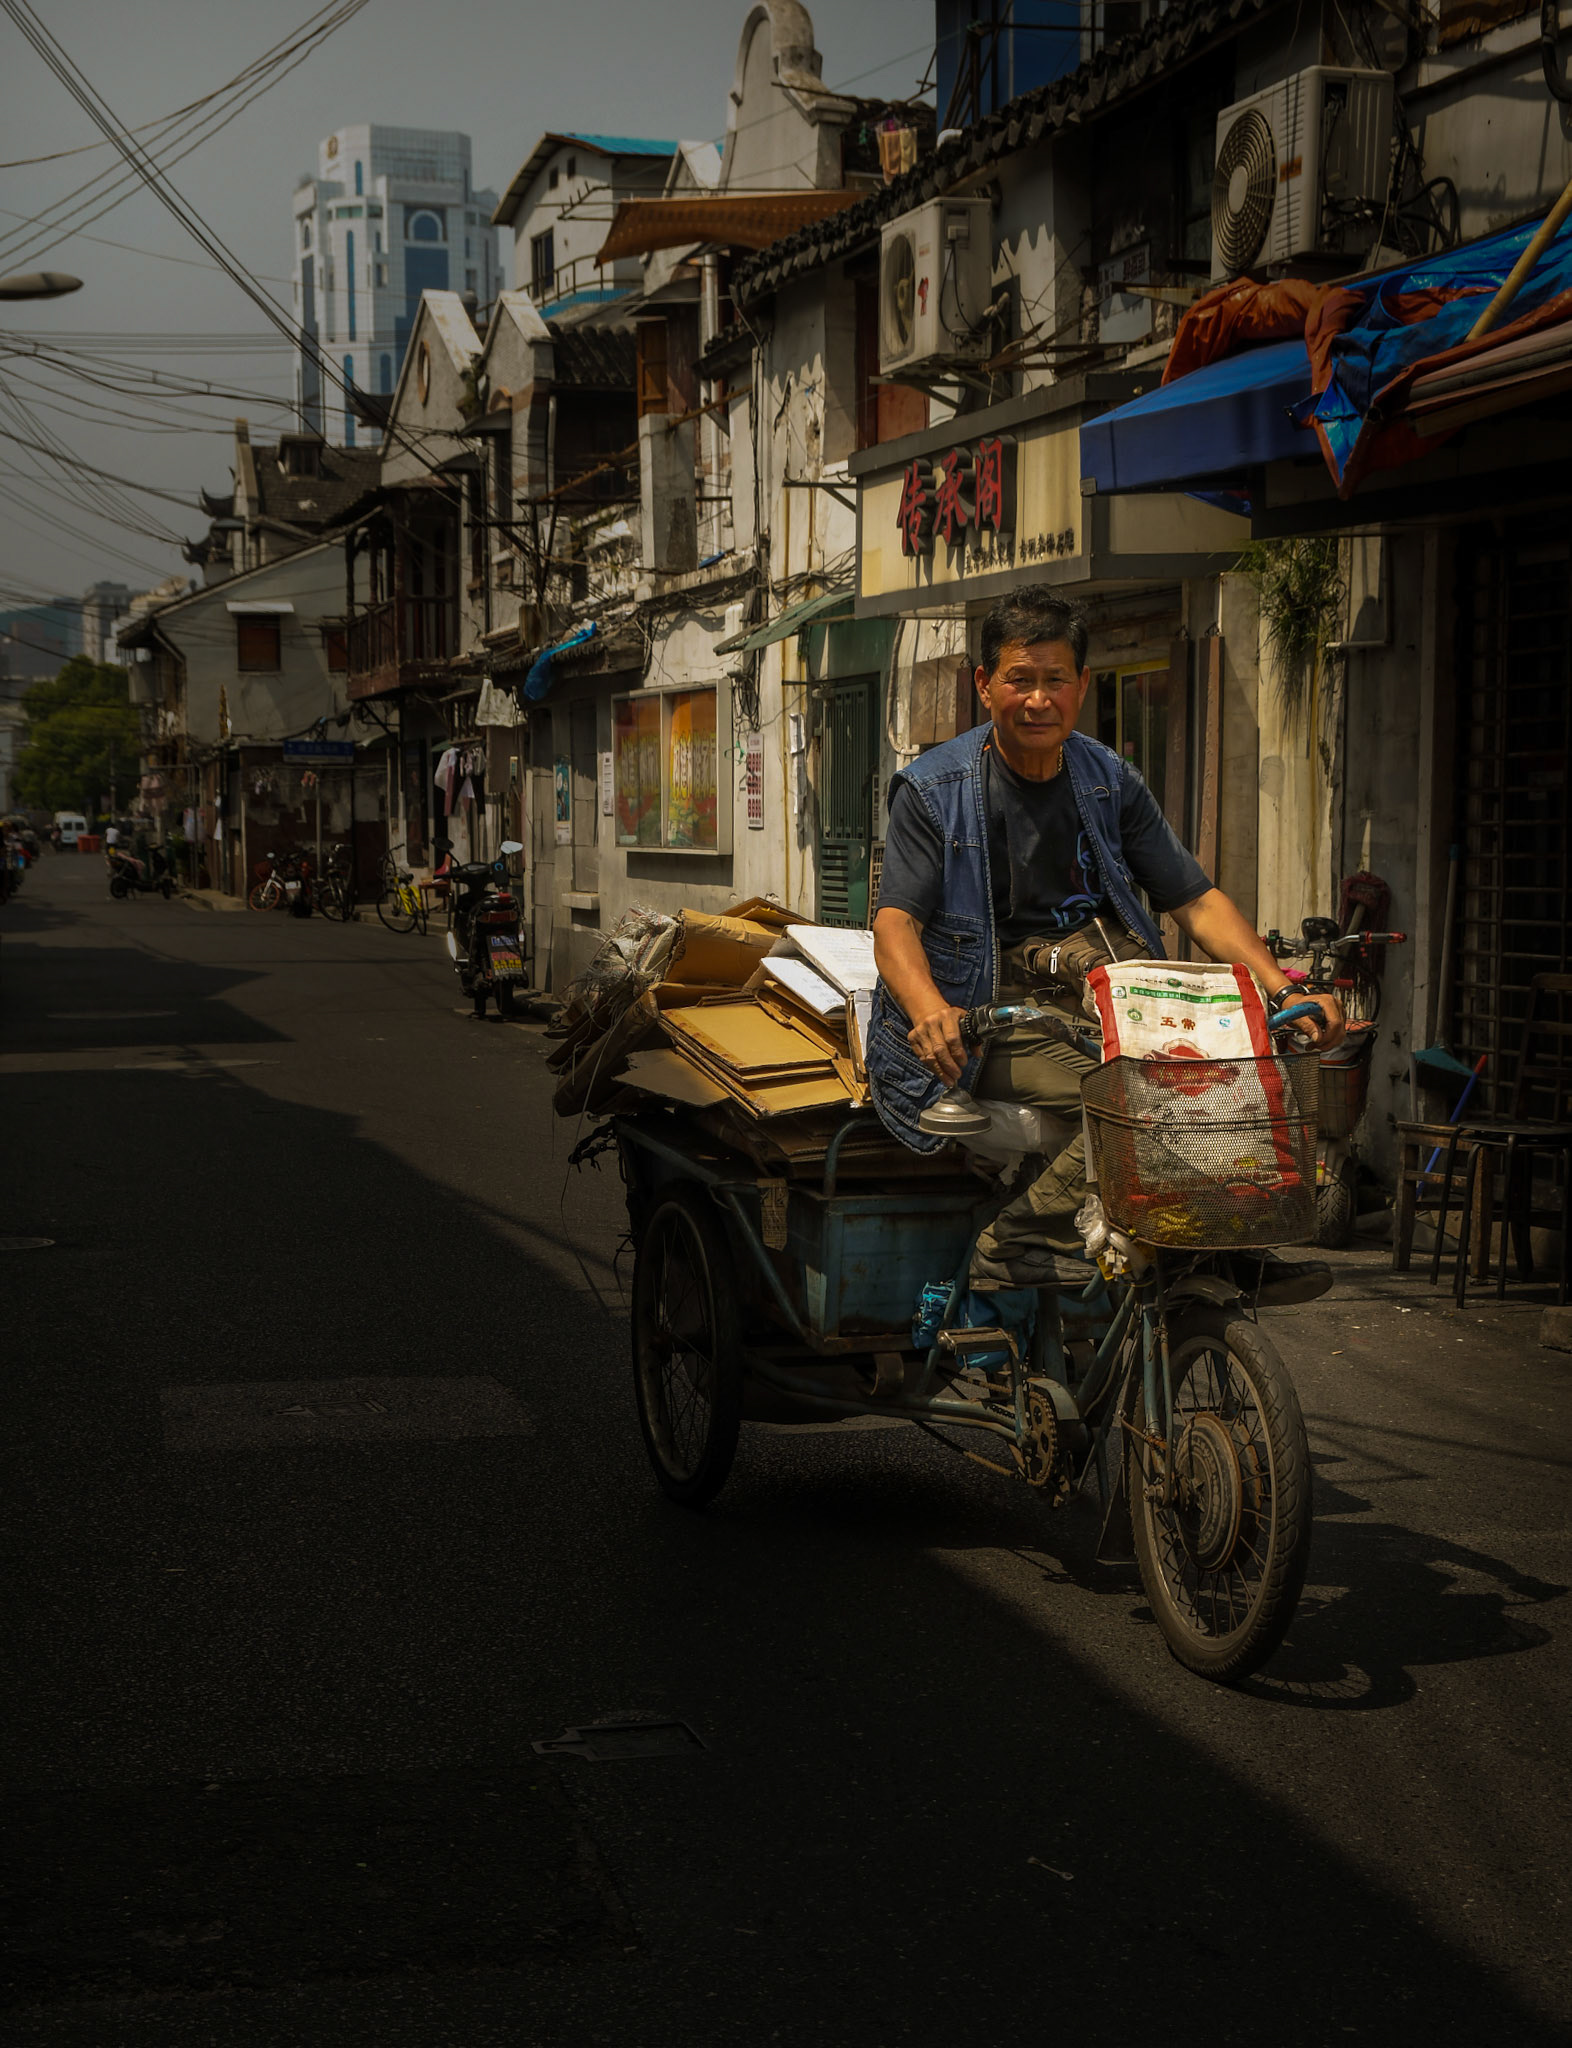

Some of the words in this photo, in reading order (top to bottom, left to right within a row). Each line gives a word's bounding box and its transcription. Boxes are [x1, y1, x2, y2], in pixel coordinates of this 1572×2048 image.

[897, 438, 1003, 556] 传承阁
[1160, 1016, 1197, 1031] 五常
